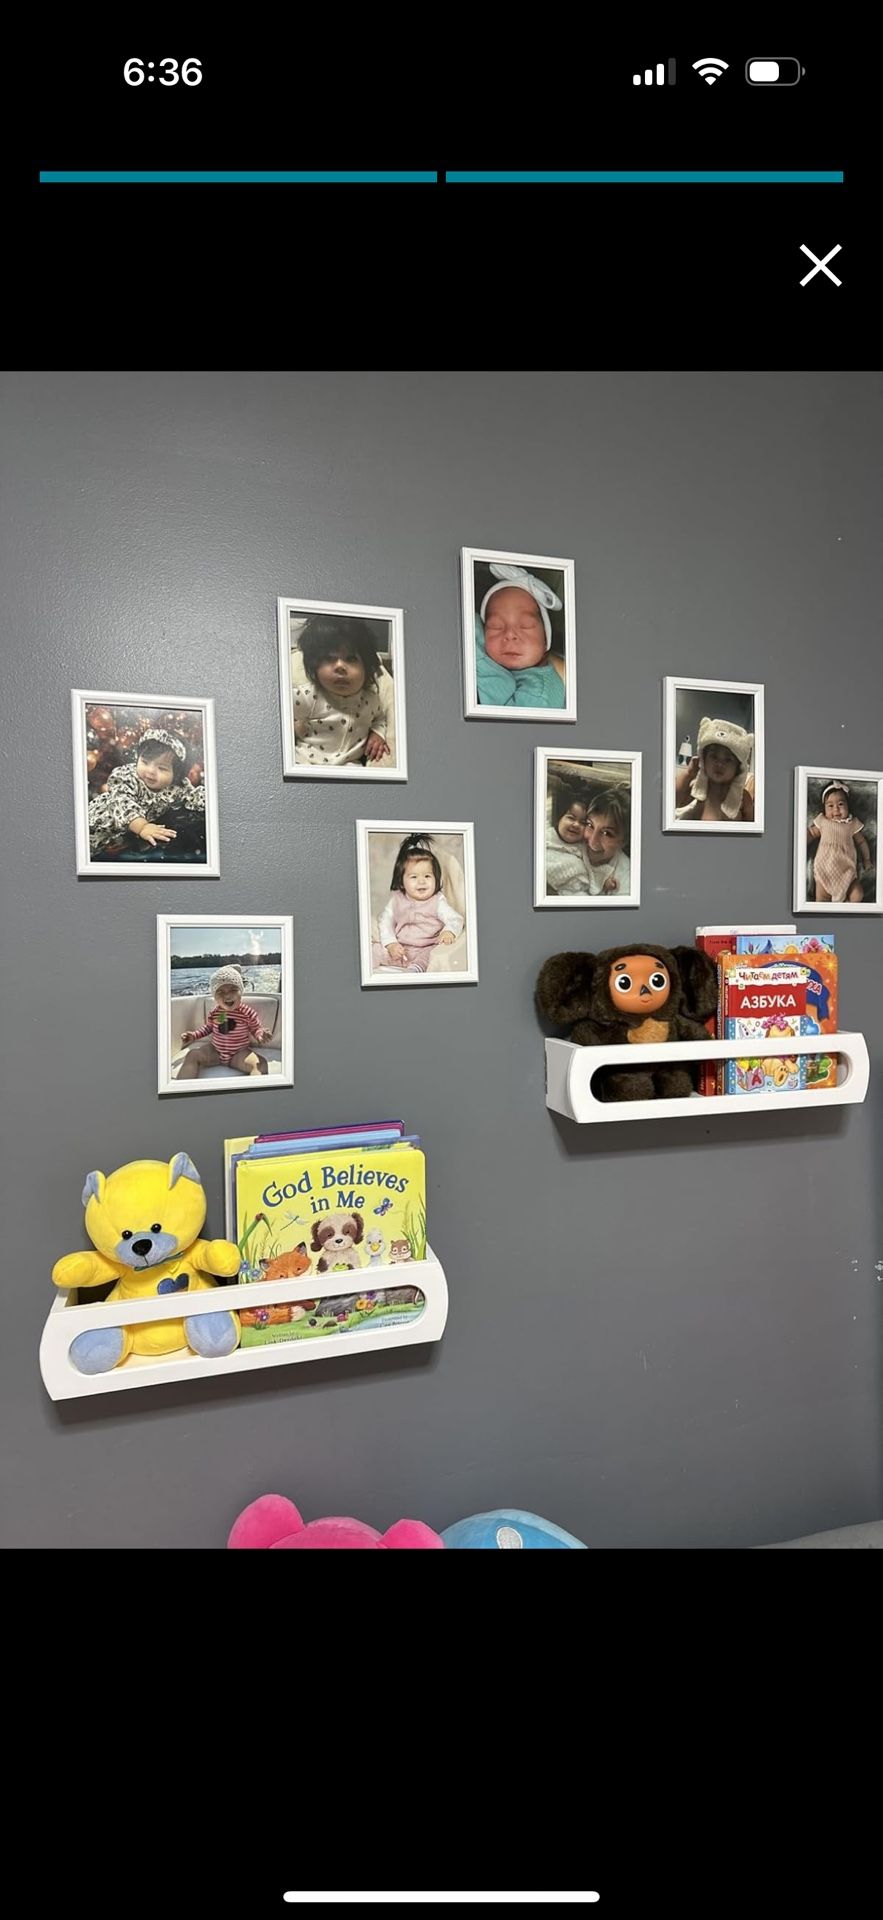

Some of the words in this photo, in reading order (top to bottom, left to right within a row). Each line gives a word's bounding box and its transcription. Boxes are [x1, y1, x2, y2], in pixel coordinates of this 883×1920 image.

[738, 971, 770, 981] Читаем
[771, 971, 799, 981] детям
[740, 994, 797, 1009] АЗБУКА
[262, 1170, 313, 1207] God
[321, 1164, 409, 1193] Believes
[310, 1196, 330, 1214] in
[336, 1190, 365, 1209] Me
